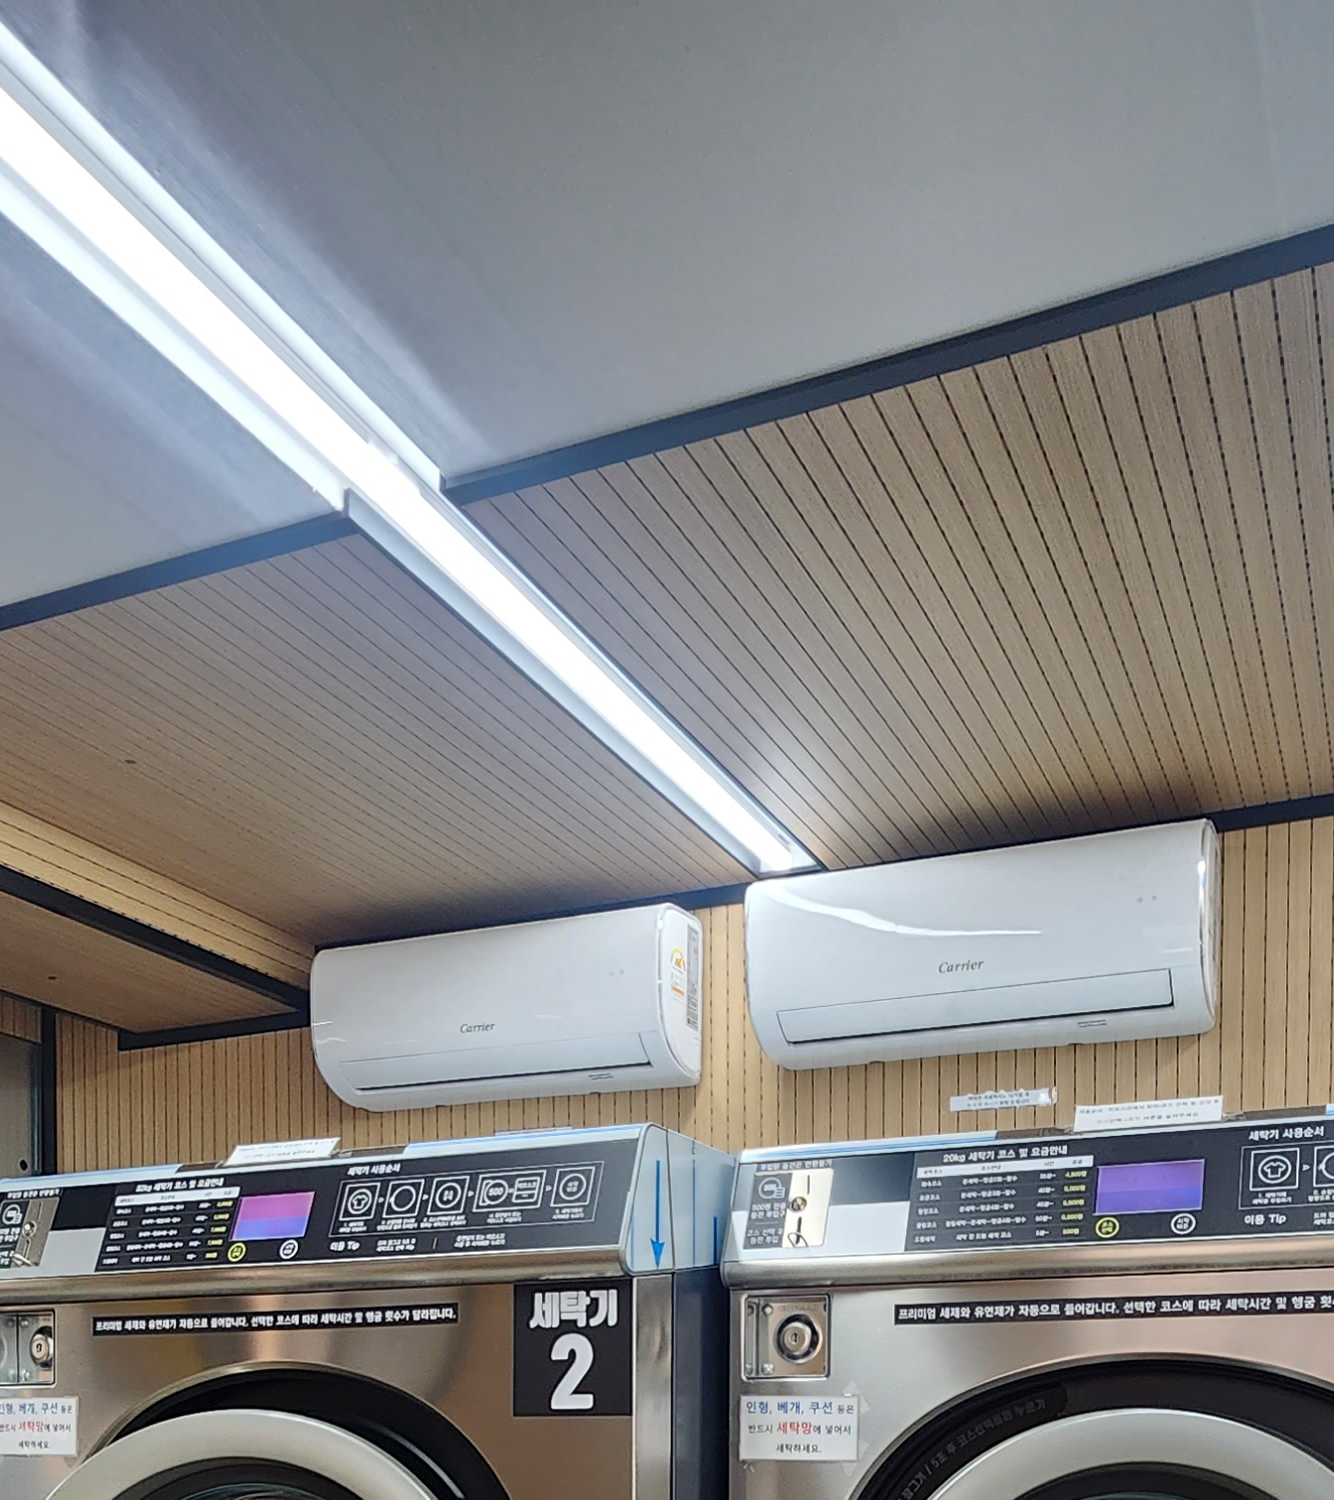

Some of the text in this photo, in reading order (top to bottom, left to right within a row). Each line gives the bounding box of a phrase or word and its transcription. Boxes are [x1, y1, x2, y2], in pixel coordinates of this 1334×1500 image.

[939, 958, 985, 974] Carrier
[459, 1022, 496, 1035] Carrier
[1248, 1126, 1325, 1141] 세탁기 사용순서
[942, 1153, 966, 1165] 20kg
[1244, 1213, 1287, 1225] 이용 Tip
[529, 1289, 617, 1329] 세탁기
[897, 1307, 936, 1320] 프리미엄
[939, 1306, 971, 1319] 세제와
[974, 1305, 1015, 1318] 유연제가
[1018, 1304, 1061, 1317] 자동으로
[1123, 1301, 1157, 1314] 선택한
[1159, 1300, 1194, 1313] 코스에
[1198, 1299, 1222, 1312] 따라
[1225, 1298, 1271, 1311] 세탁시간
[551, 1333, 594, 1410] 2
[746, 1401, 772, 1415] 인형,
[777, 1401, 804, 1415] 베개,
[809, 1401, 834, 1414] 쿠션
[748, 1423, 773, 1434] 반드시
[825, 1424, 852, 1435] 넣어서
